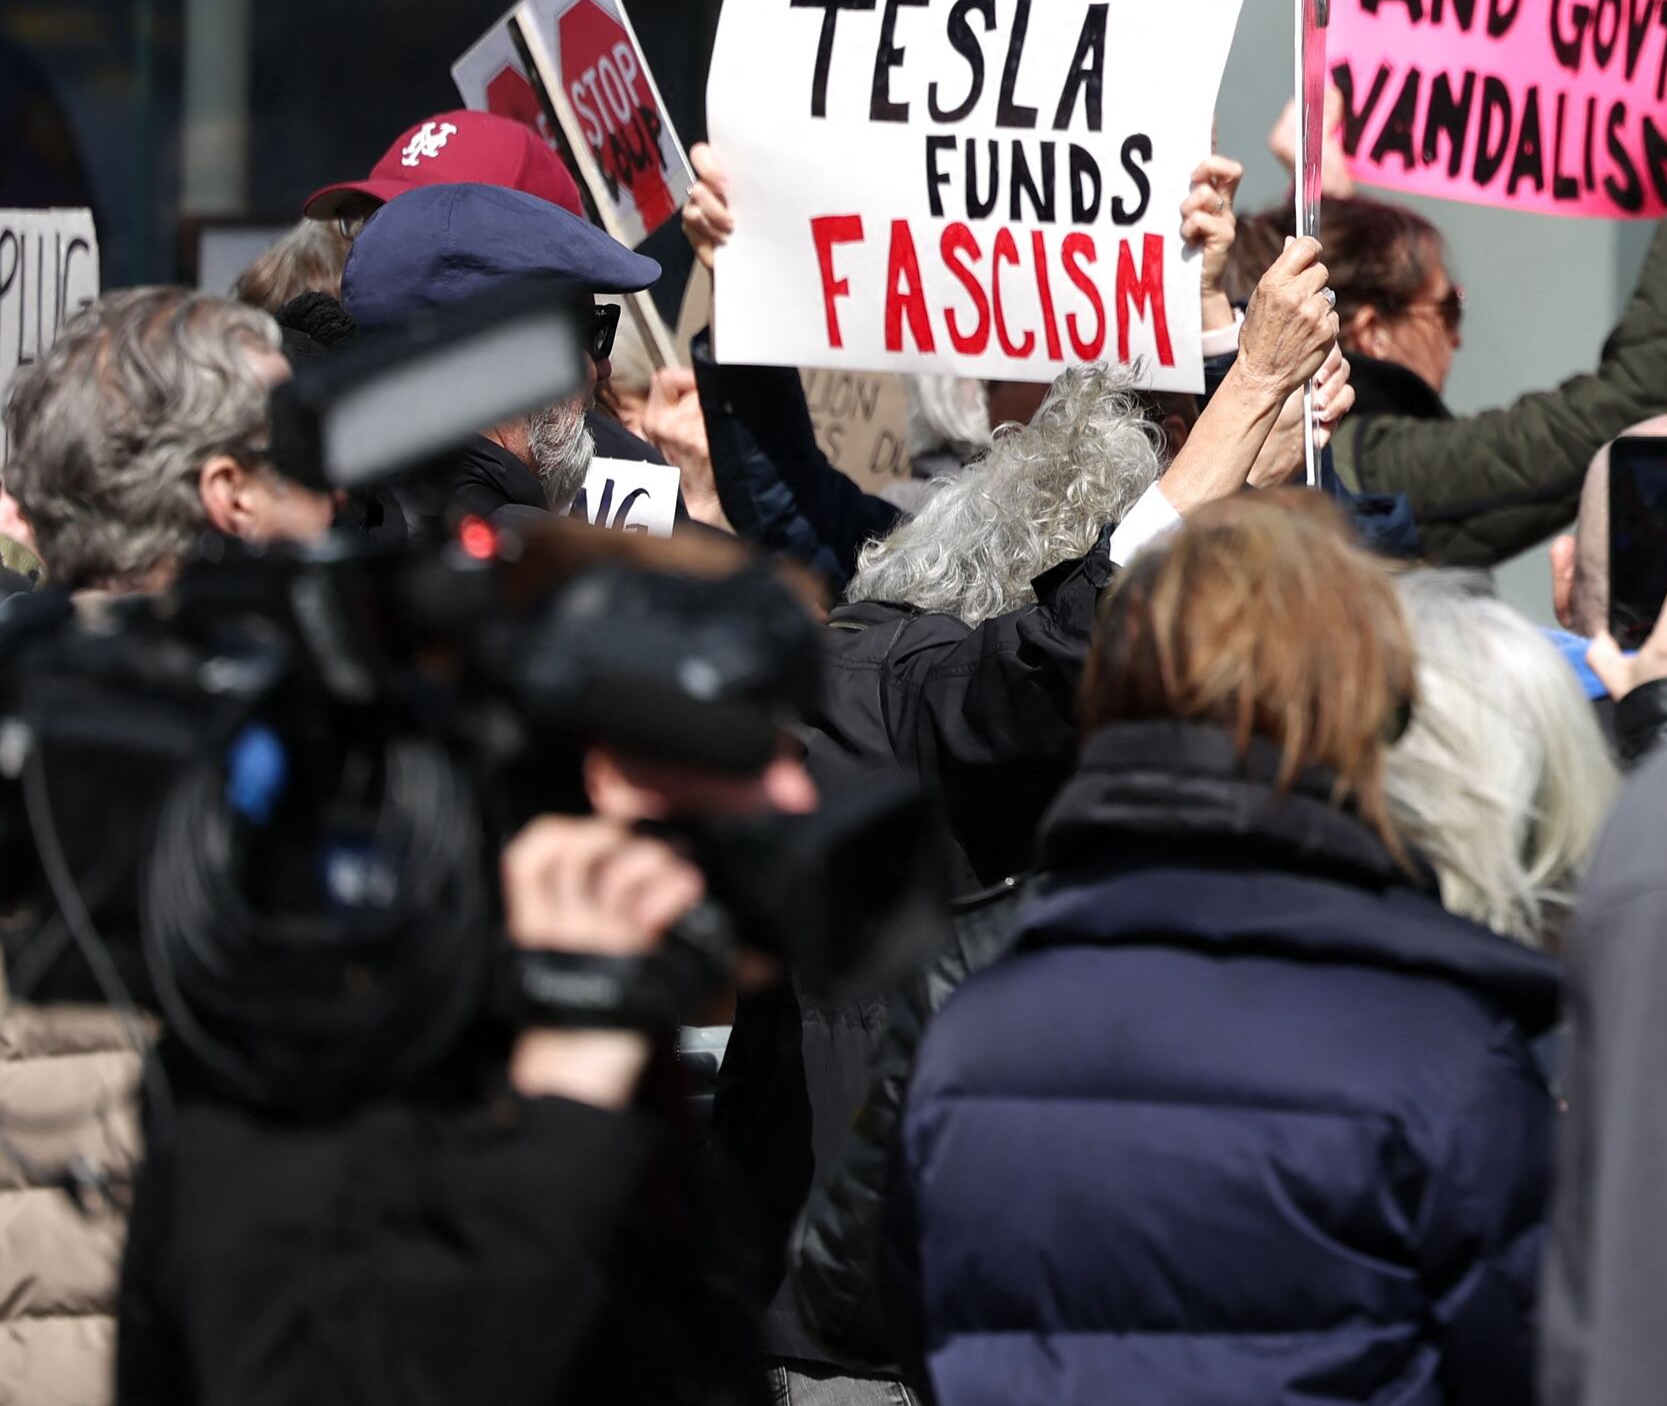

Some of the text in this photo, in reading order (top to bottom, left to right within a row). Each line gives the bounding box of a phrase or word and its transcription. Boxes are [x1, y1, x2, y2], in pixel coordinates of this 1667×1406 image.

[571, 41, 640, 148] STOP
[924, 132, 1155, 228] FUNDS
[809, 213, 1176, 369] FASCISM
